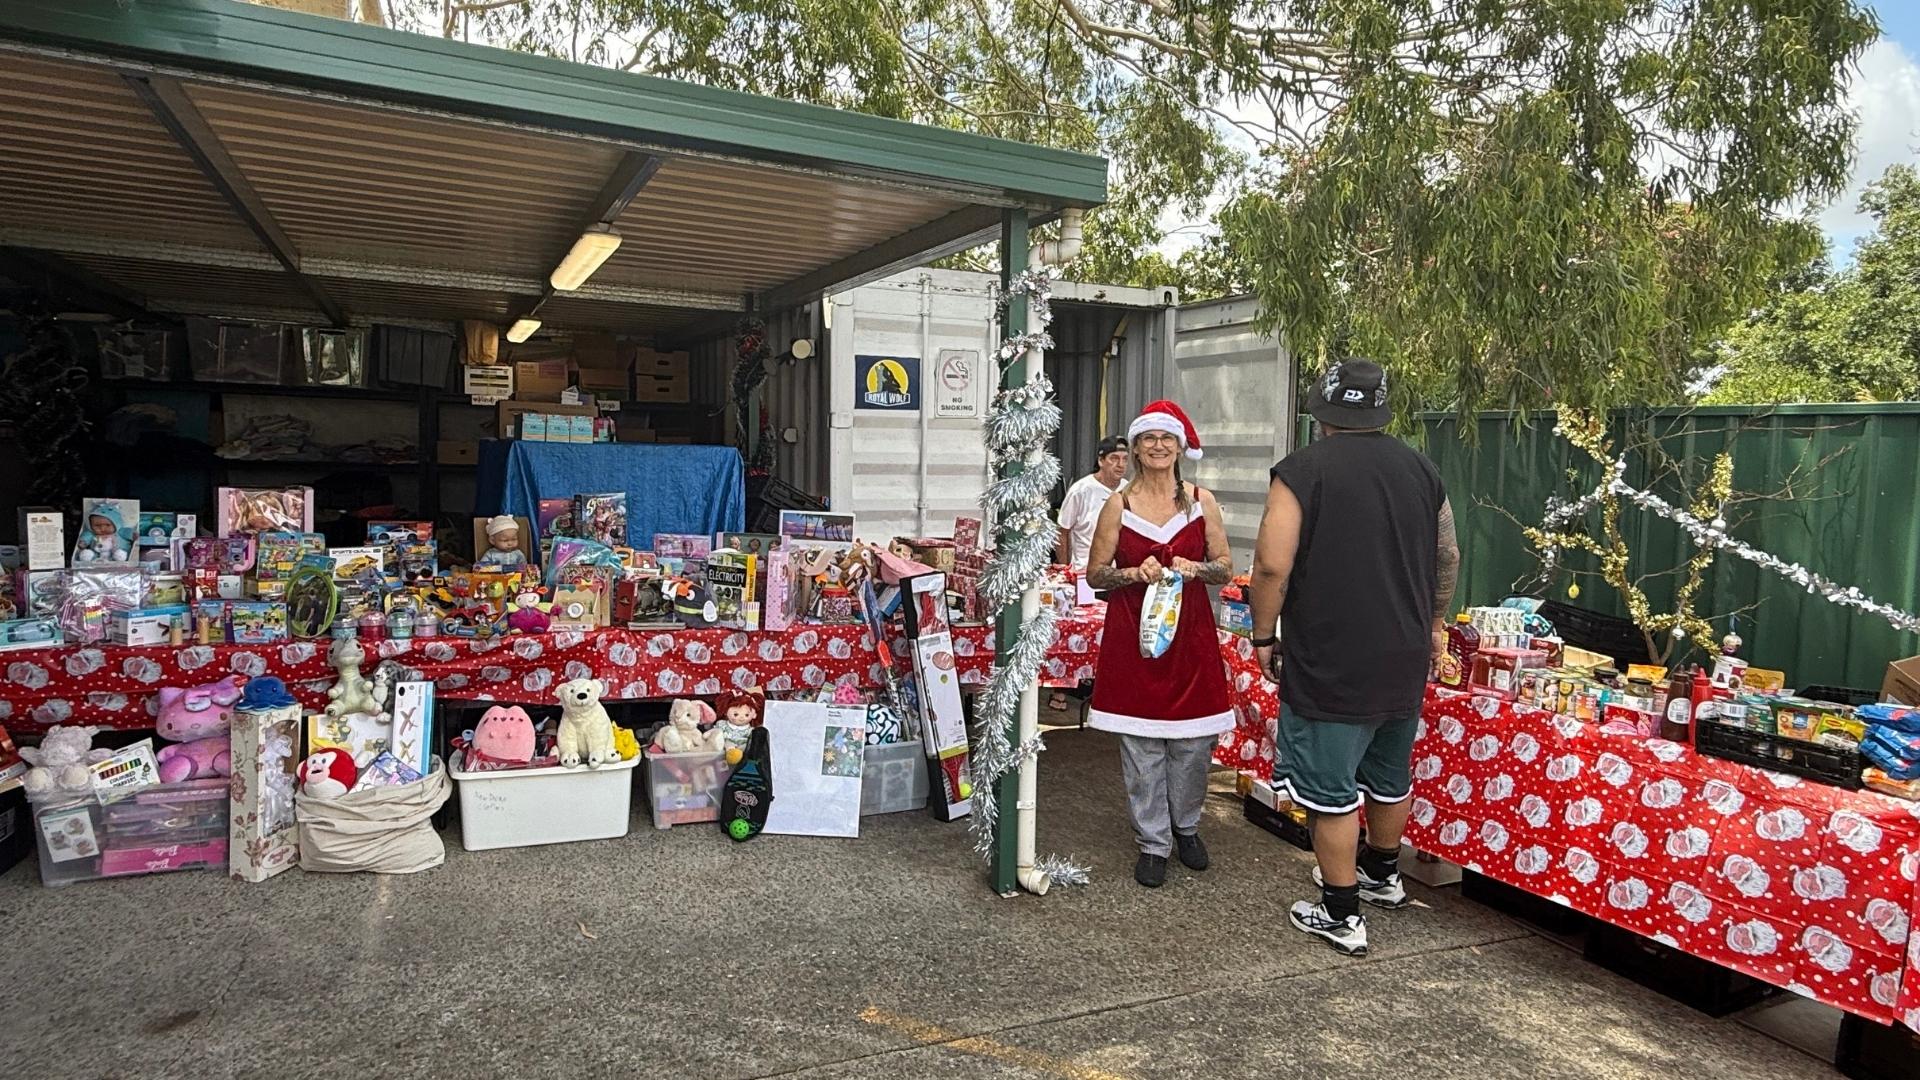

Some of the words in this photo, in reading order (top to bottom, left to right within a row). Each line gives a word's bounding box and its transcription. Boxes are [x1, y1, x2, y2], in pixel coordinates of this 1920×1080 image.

[868, 392, 888, 404] ROYAL
[889, 392, 907, 404] WOLF
[708, 569, 745, 583] ELECTRICITY
